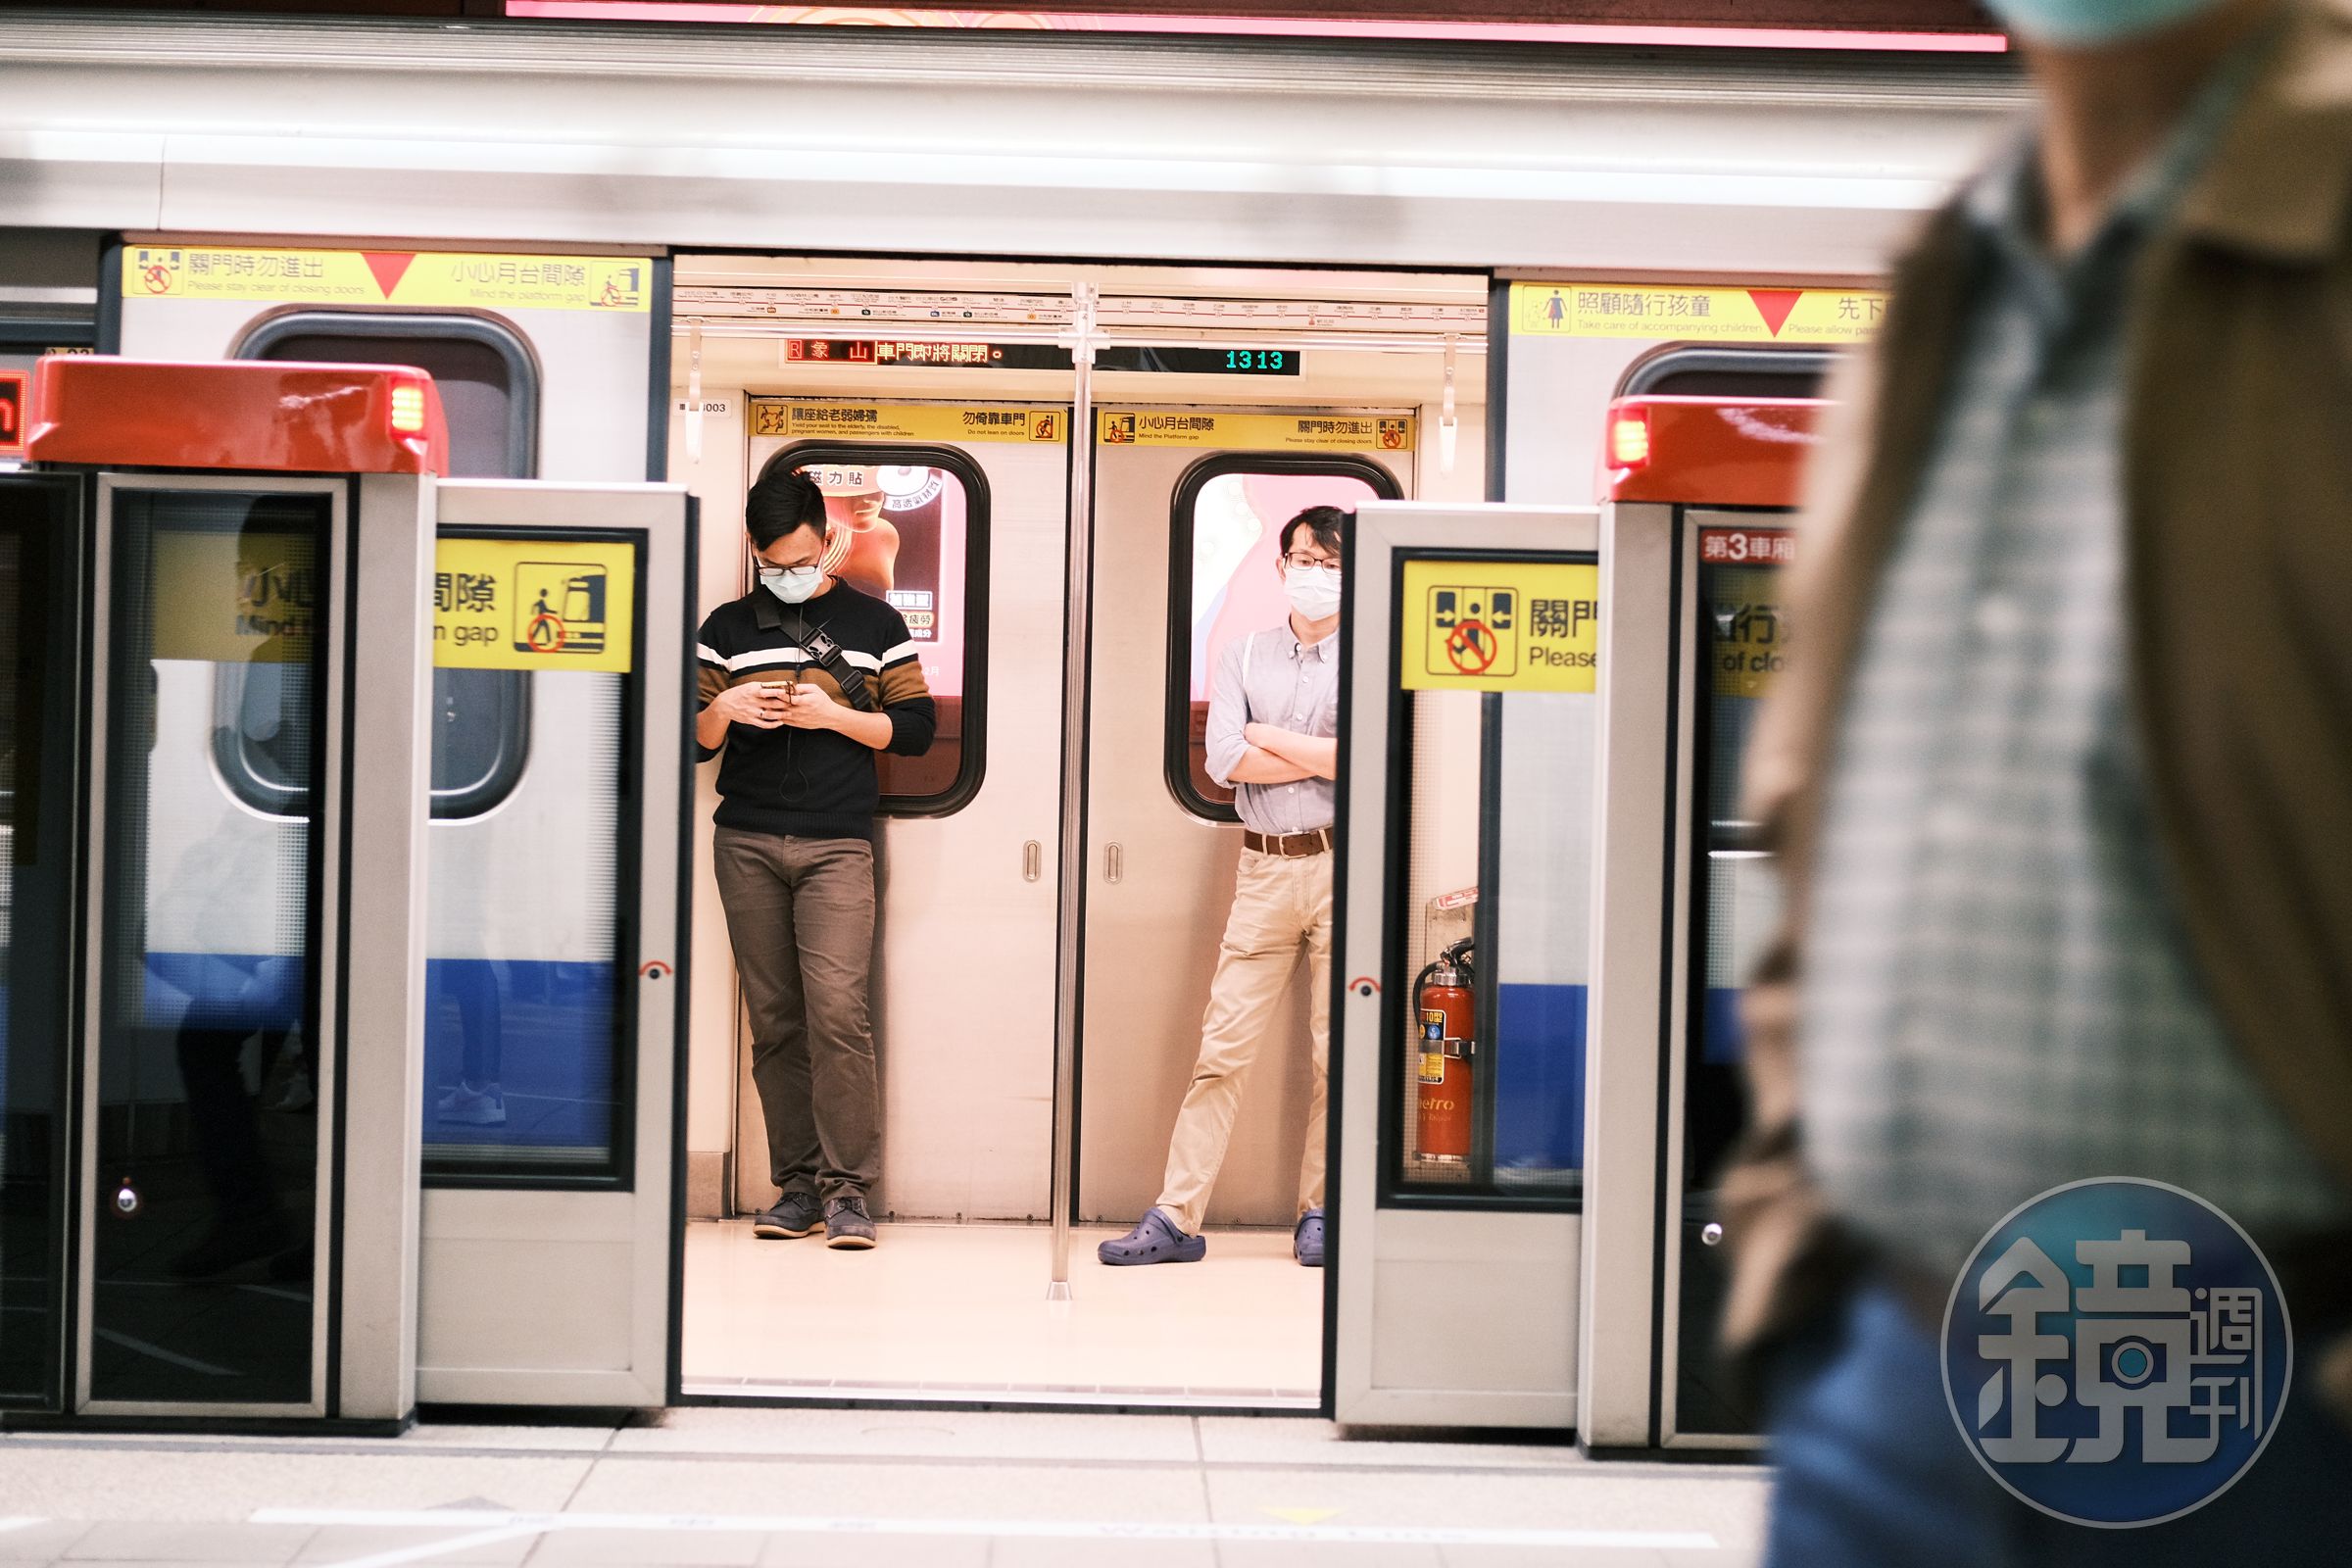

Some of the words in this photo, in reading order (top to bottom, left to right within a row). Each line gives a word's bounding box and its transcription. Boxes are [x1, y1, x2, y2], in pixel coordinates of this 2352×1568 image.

[188, 253, 323, 278] 關門時勿進出
[451, 261, 586, 287] 小心月台間隙
[188, 280, 222, 291] Please
[226, 282, 247, 293] stay
[293, 284, 330, 296] closing
[334, 285, 365, 295] doors
[470, 288, 496, 299] Mind
[499, 289, 514, 300] the
[565, 293, 586, 303] gap
[1578, 292, 1711, 317] 照顧隨行孩童
[1838, 297, 1892, 320] 先下
[1578, 319, 1601, 330] Take
[1603, 321, 1626, 330] care
[1629, 320, 1640, 330] of
[1642, 322, 1718, 334] accompanying
[1720, 323, 1762, 333] children
[1788, 323, 1823, 333] Please
[1825, 324, 1852, 334] allow
[703, 403, 726, 413] 003
[792, 407, 878, 422] 讓座給老弱婦孺
[962, 412, 1025, 426] 勿倚靠車門
[1139, 416, 1214, 431] 小心月台間隙
[1298, 419, 1373, 434] 關門時勿進出
[1705, 533, 1795, 560] 第3車廂
[454, 625, 499, 647] gap
[1723, 652, 1745, 671] of
[1420, 1098, 1455, 1110] etro
